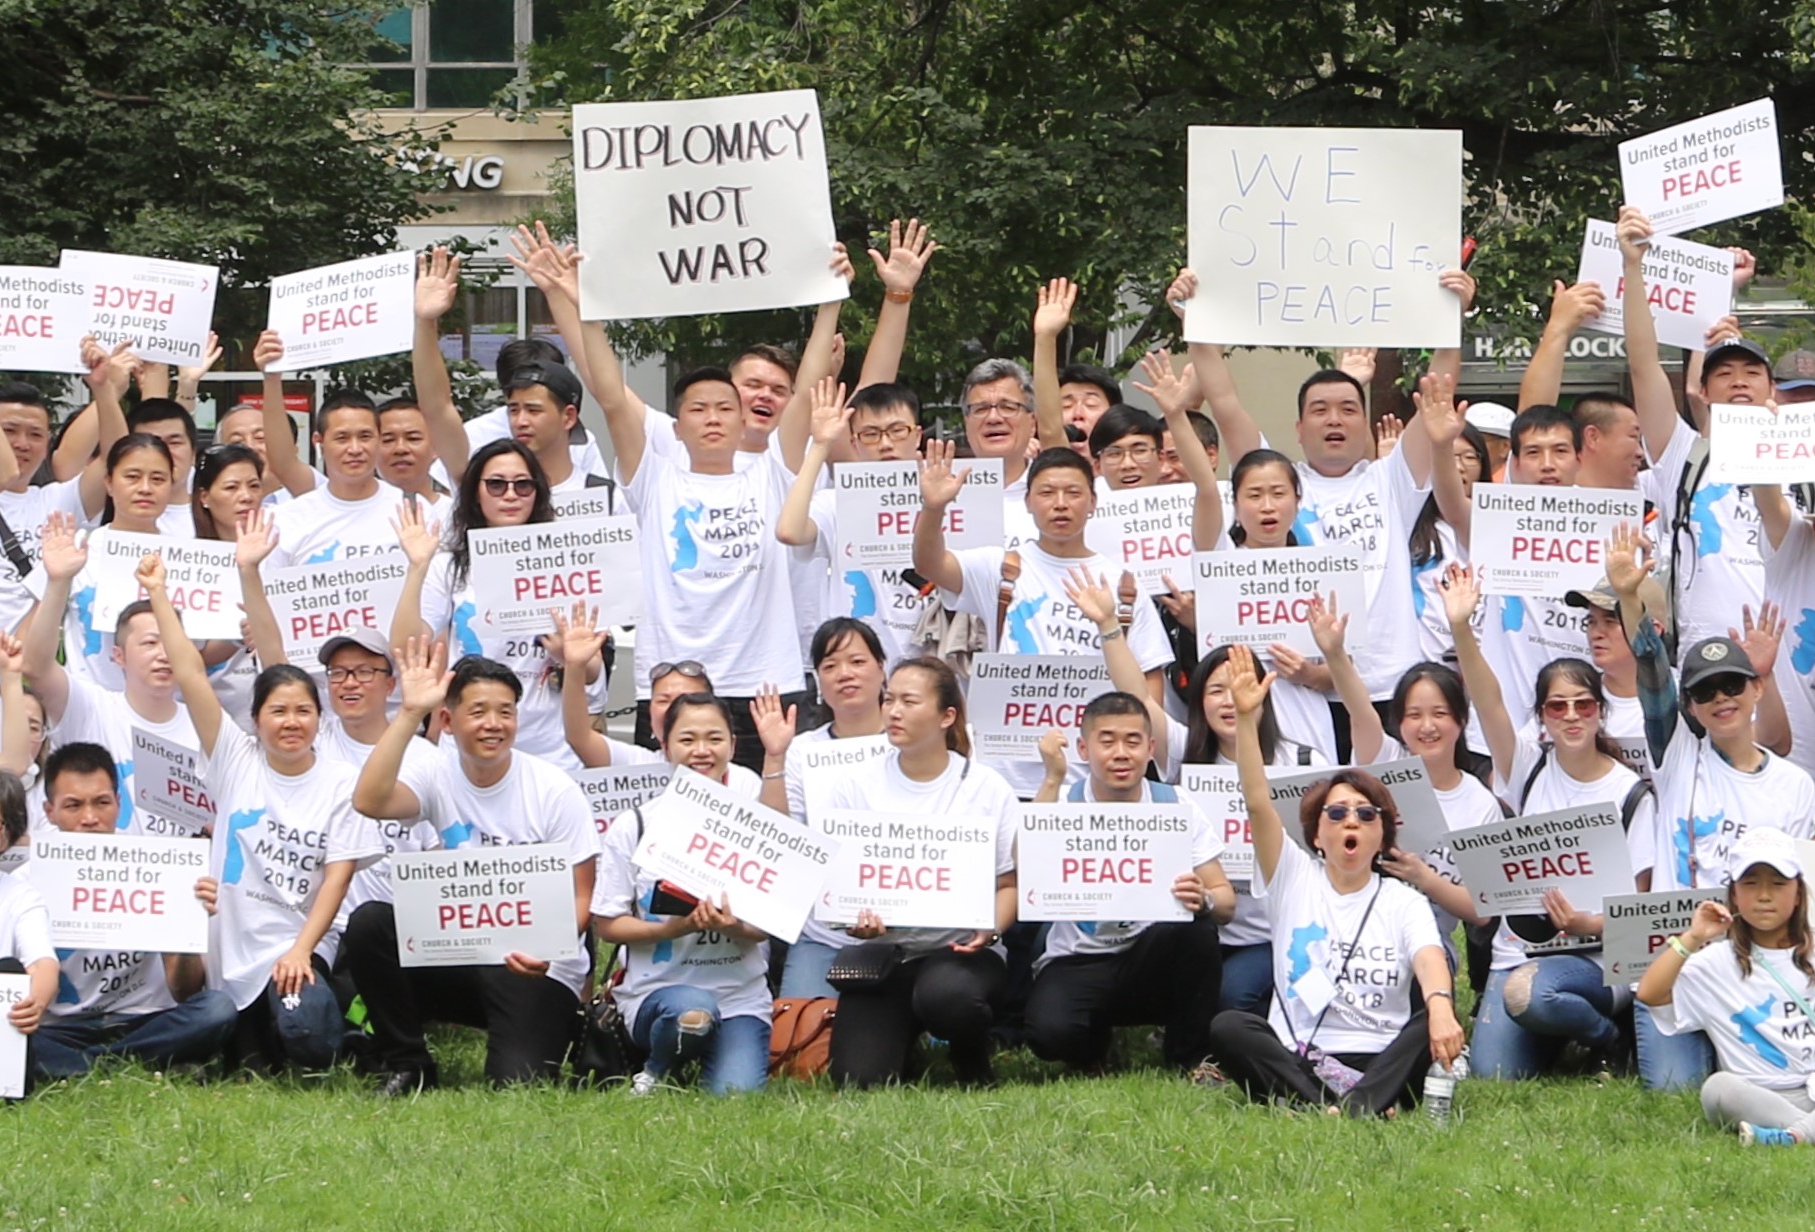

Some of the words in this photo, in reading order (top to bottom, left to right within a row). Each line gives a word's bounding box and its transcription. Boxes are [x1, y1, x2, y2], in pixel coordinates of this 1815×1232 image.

[582, 112, 811, 170] DIPLOMACY
[1628, 139, 1678, 166] United
[1682, 115, 1770, 150] Methodists
[1664, 152, 1709, 173] stand
[1713, 142, 1736, 161] for
[1232, 147, 1361, 203] WE
[1661, 160, 1742, 201] PEACE
[668, 186, 752, 228] NOT
[1218, 204, 1395, 271] Stand
[659, 237, 771, 285] WAR
[276, 279, 322, 300] United
[328, 262, 410, 289] Methodists
[306, 290, 349, 308] stand
[353, 284, 375, 300] for
[302, 303, 378, 335] PEACE
[1257, 282, 1392, 326] PEACE
[1478, 495, 1534, 512] United
[1540, 498, 1637, 517] Methodists
[1517, 516, 1567, 533] stand
[1572, 518, 1597, 534] for
[1512, 537, 1600, 564] PEACE
[1493, 569, 1520, 578] CHURCH
[1530, 570, 1559, 579] SOCIETY
[267, 820, 327, 850] PEACE
[1024, 815, 1084, 832] United
[1089, 815, 1188, 832] Methodists
[255, 839, 323, 872] MARCH
[1066, 835, 1117, 852] stand
[1122, 835, 1148, 852] for
[263, 867, 310, 896] 2018
[1061, 857, 1152, 885] PEACE
[1042, 892, 1073, 902] CHURCH
[1083, 892, 1113, 902] SOCIETY
